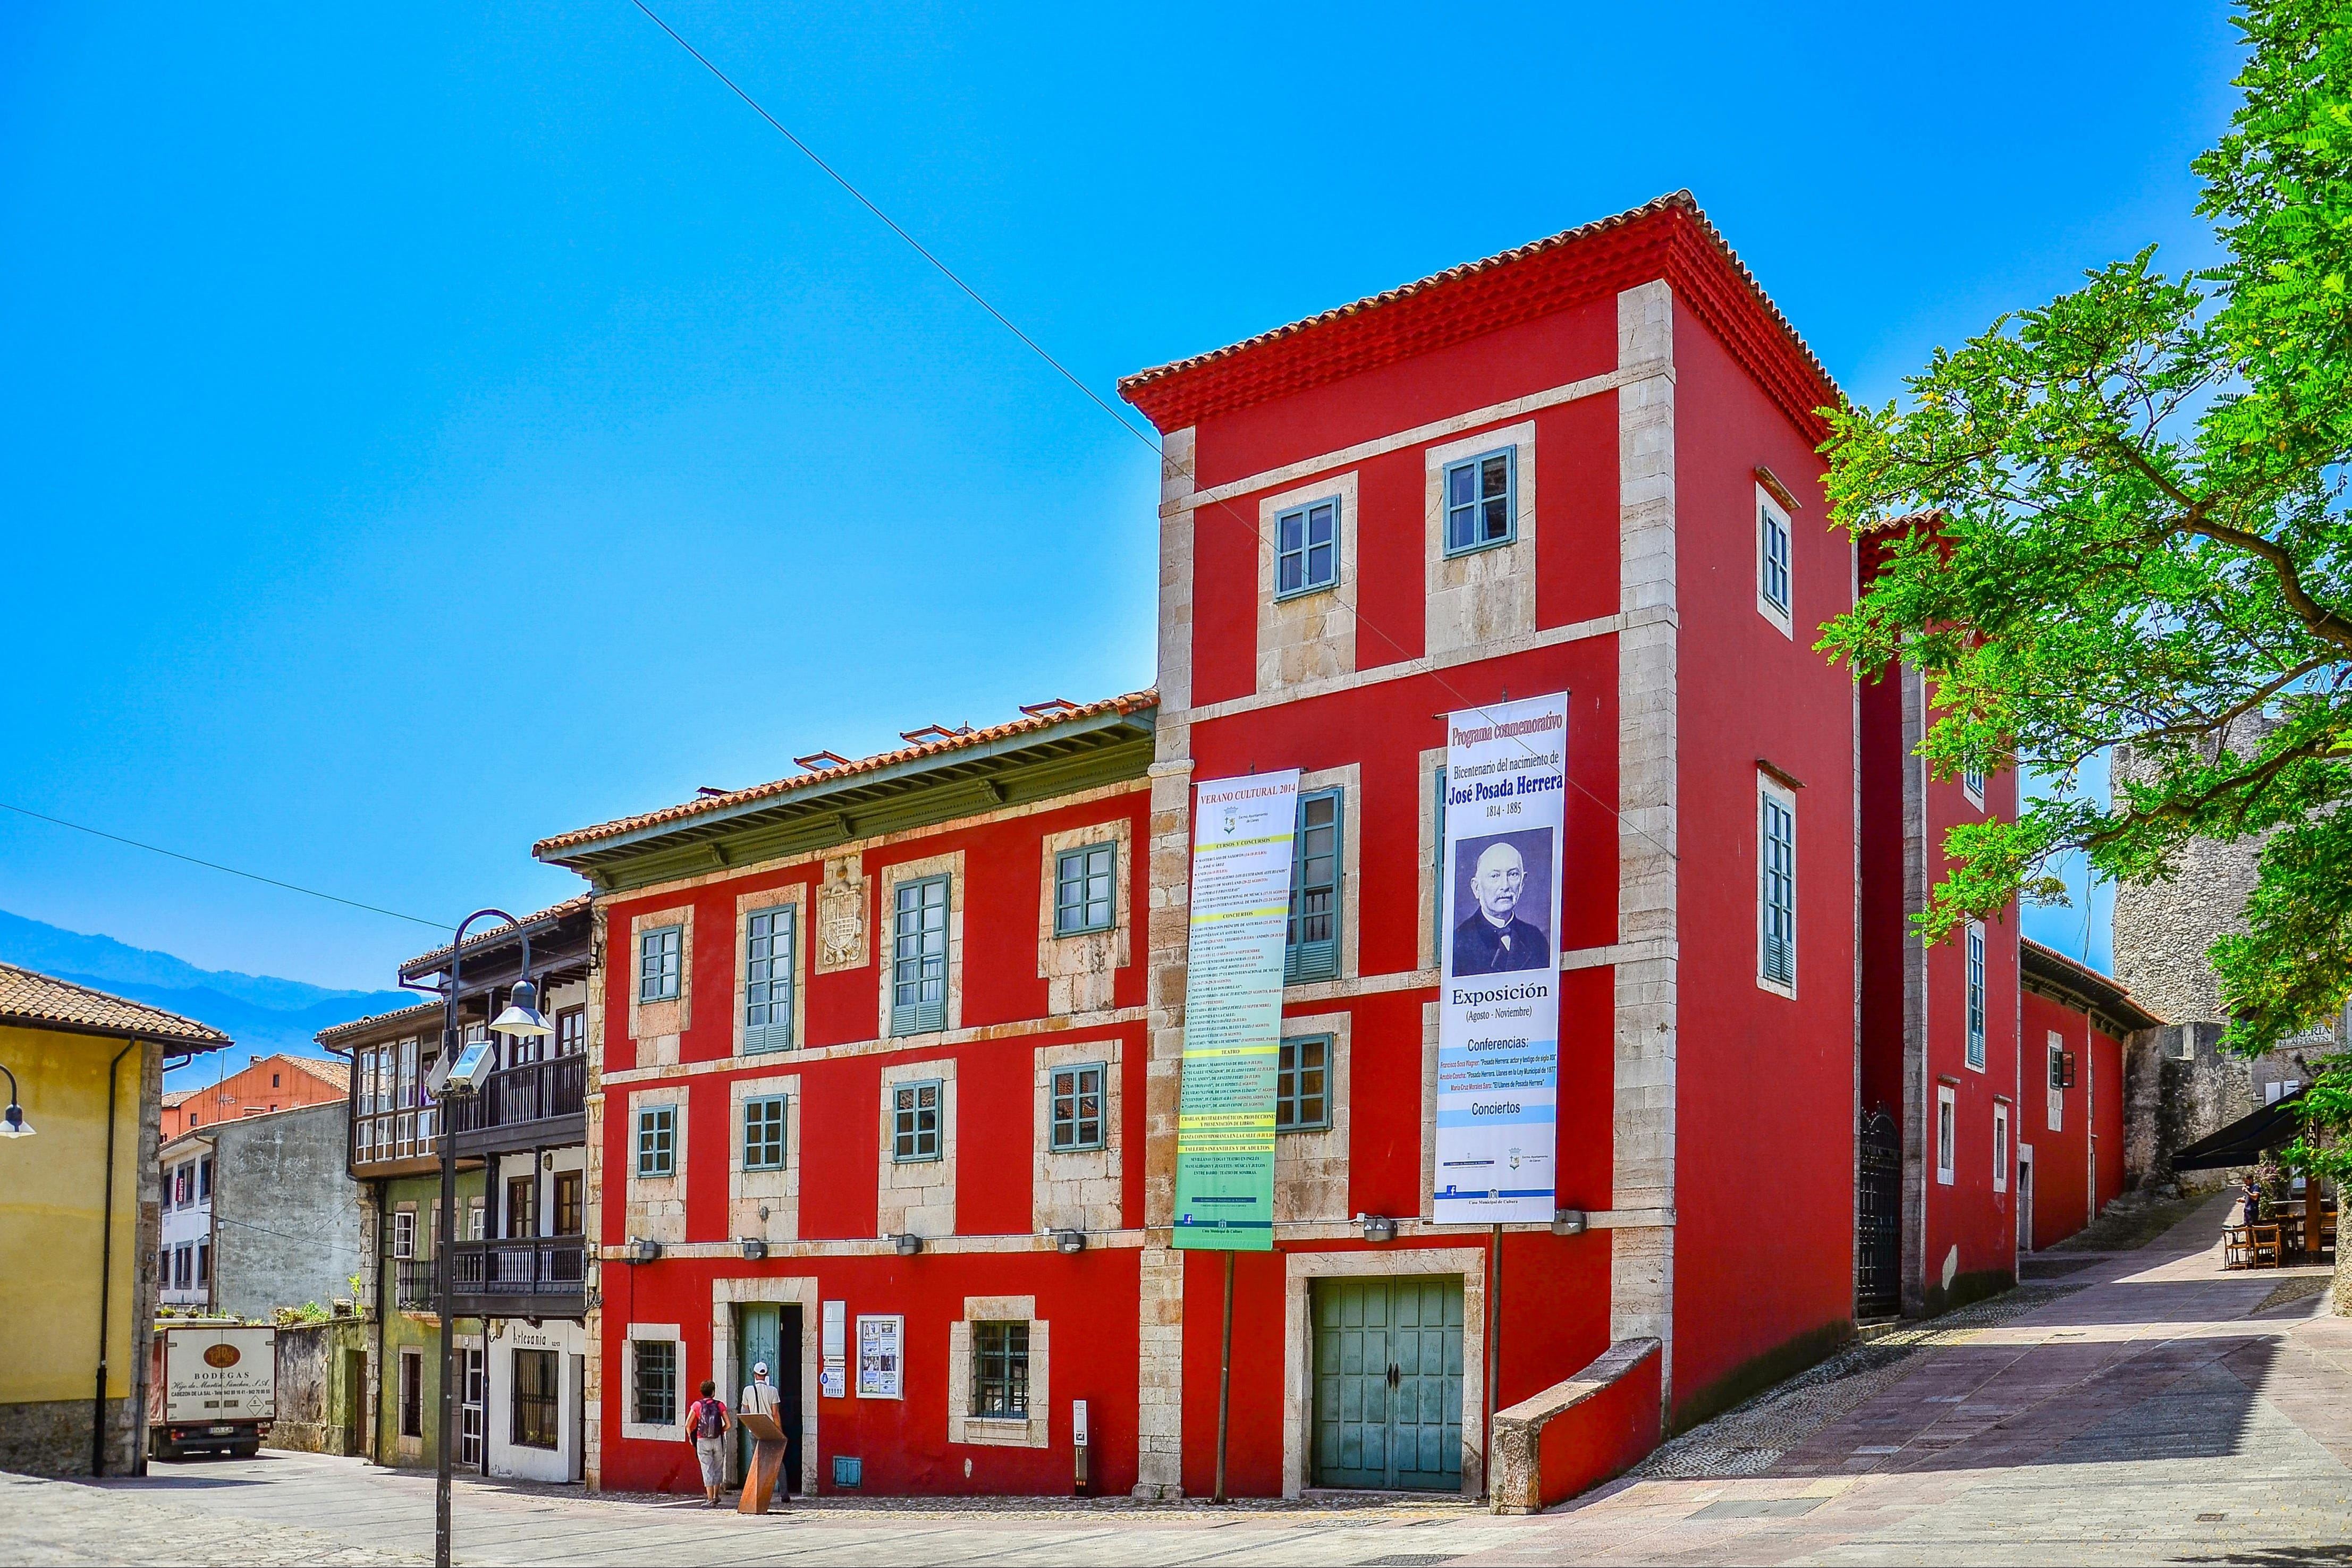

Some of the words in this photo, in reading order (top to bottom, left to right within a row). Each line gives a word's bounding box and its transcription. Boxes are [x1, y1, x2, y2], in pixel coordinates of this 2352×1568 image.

[1452, 726, 1492, 749] Programa
[1494, 710, 1562, 739] conmemorativo
[1453, 760, 1495, 779] Bicentenario
[1497, 757, 1507, 772] del
[1509, 754, 1548, 770] nacimiento
[1550, 749, 1559, 764] de
[1200, 792, 1233, 804] VERANO
[1234, 785, 1277, 800] CULTURAL
[1280, 783, 1295, 793] 2014
[1449, 784, 1473, 806] José
[1475, 778, 1513, 801] Posada
[1517, 774, 1563, 795] Herrera
[1486, 804, 1500, 819] 1814
[1507, 801, 1521, 815] 1885
[1452, 982, 1547, 1007] Exposición
[1466, 1008, 1490, 1023] (Agosto
[1495, 1005, 1532, 1020] Noviembre)
[1468, 1035, 1529, 1052] Conferencias:
[1524, 1067, 1541, 1076] Municipal
[1471, 1100, 1520, 1115] Conciertos
[513, 1326, 546, 1345] Artesania
[171, 1381, 187, 1391] Hijo
